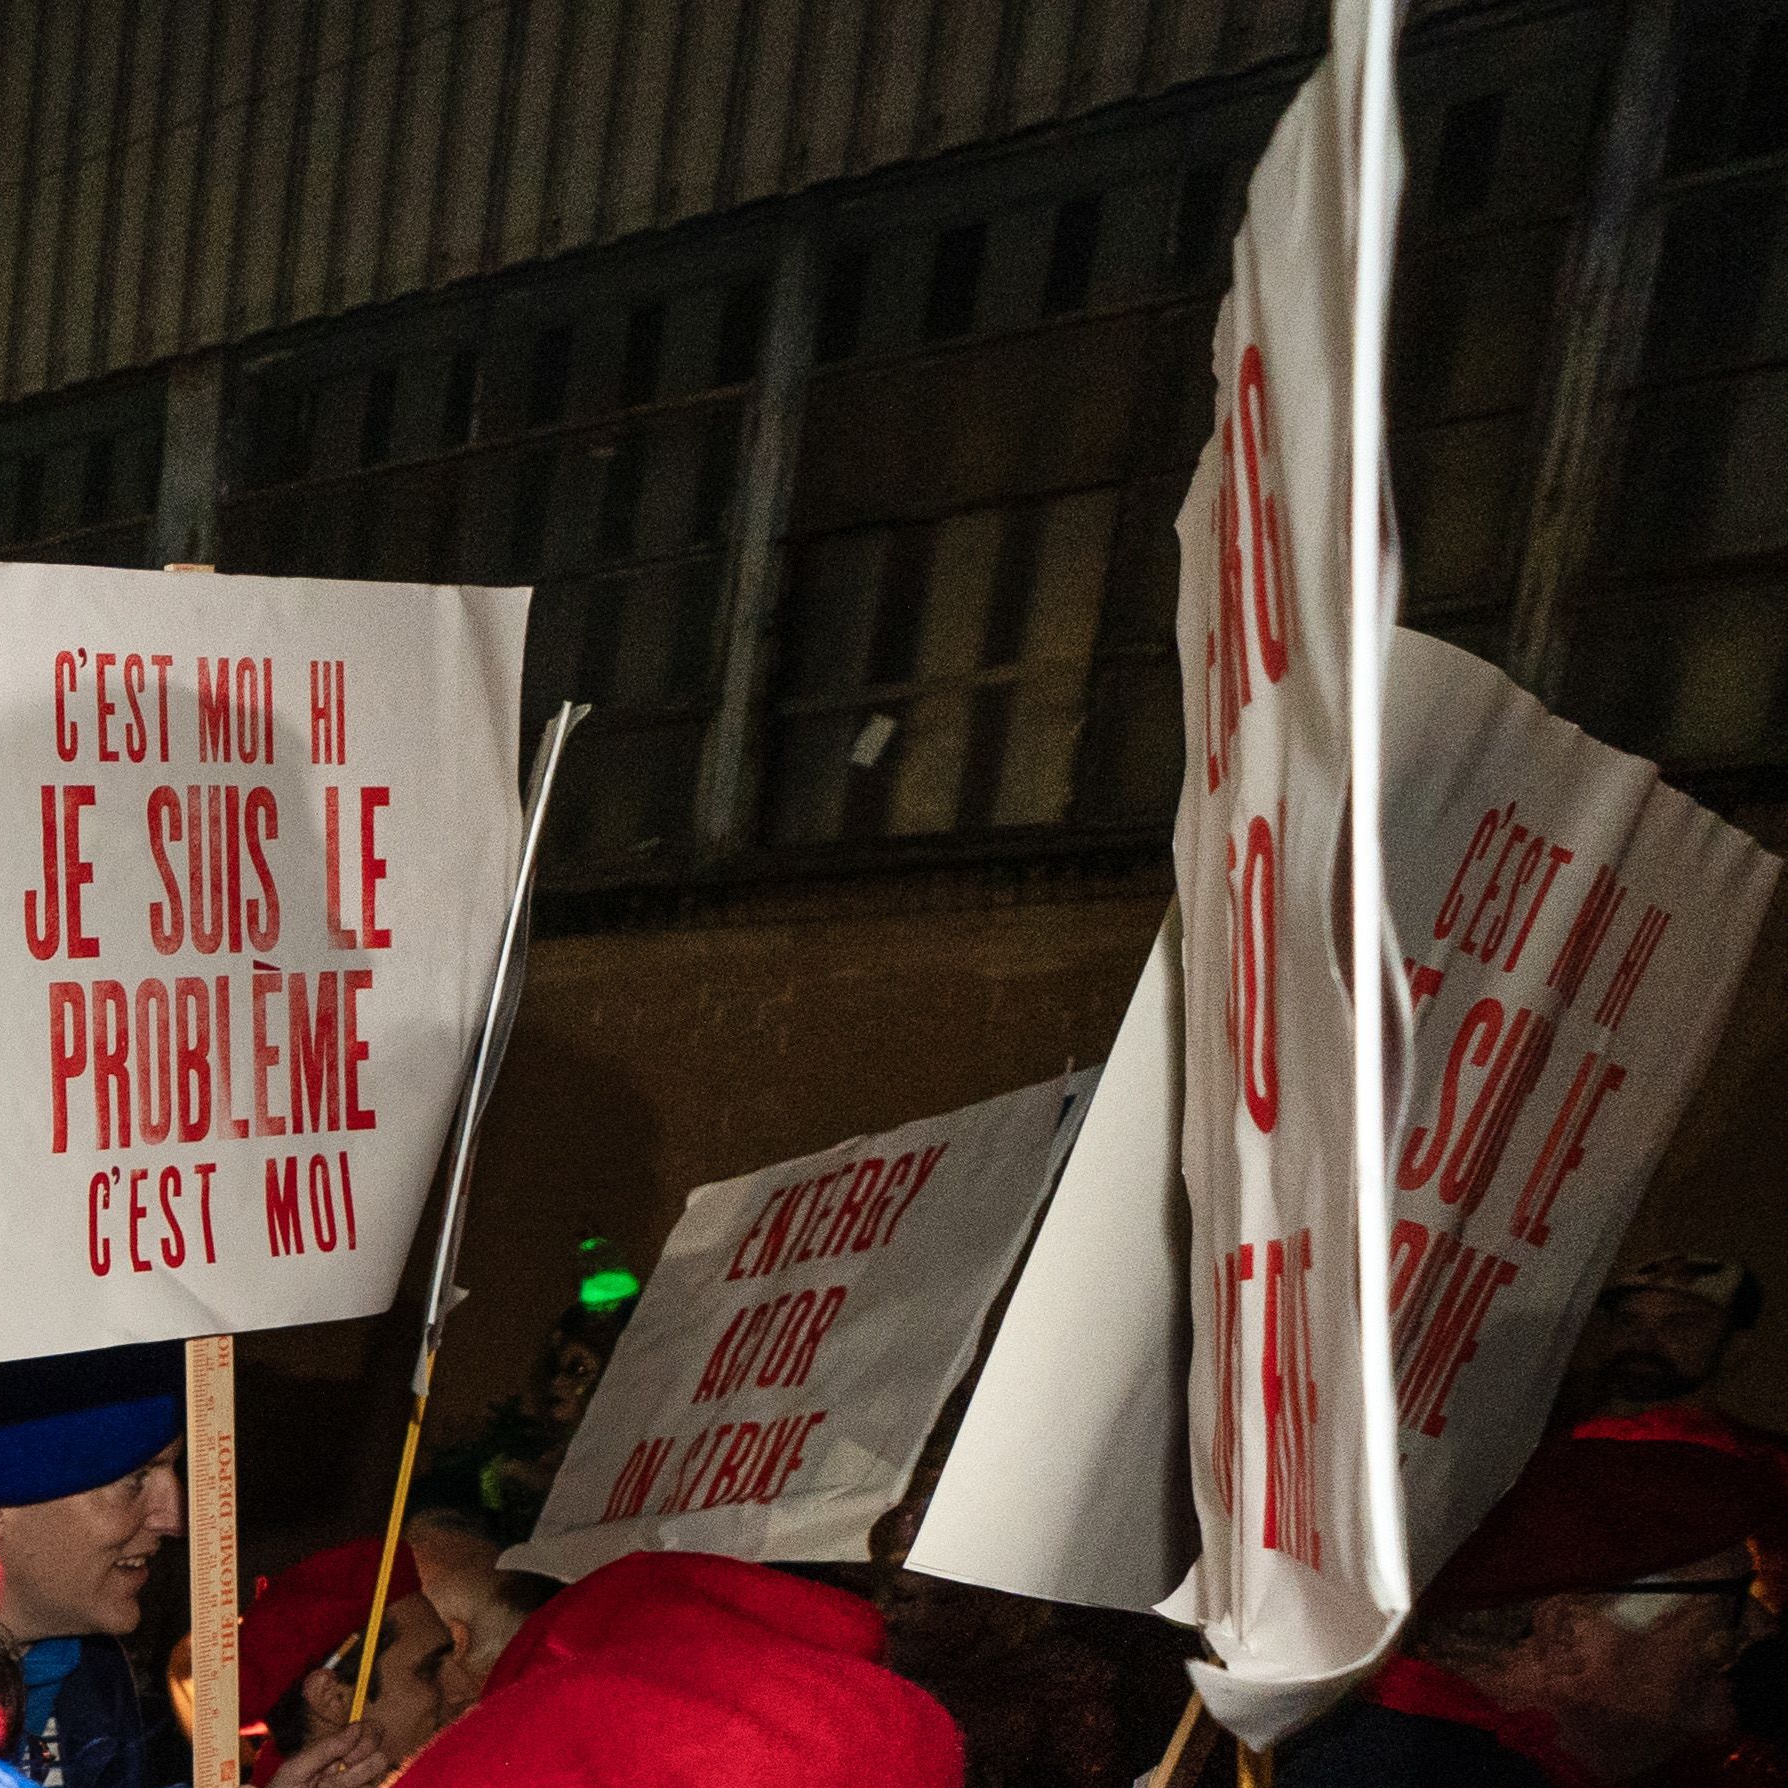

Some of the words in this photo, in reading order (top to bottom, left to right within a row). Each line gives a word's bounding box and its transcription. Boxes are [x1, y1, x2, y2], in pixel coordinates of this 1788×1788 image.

[54, 647, 173, 763] C'EST
[197, 656, 274, 766] MOI
[310, 660, 345, 766] HI
[24, 785, 100, 960] JE
[147, 785, 281, 955] SUIS
[325, 785, 392, 950] LE
[1433, 800, 1574, 972] C'EST
[49, 960, 377, 1153] PROBLÈME
[88, 1163, 218, 1277] C'EST
[265, 1151, 358, 1258] MOI
[727, 1142, 950, 1281] ENTERGY
[693, 1286, 847, 1404] ACTOR
[218, 1431, 234, 1519] DEPOT
[602, 1437, 675, 1524] ON
[220, 1524, 234, 1607] HOME
